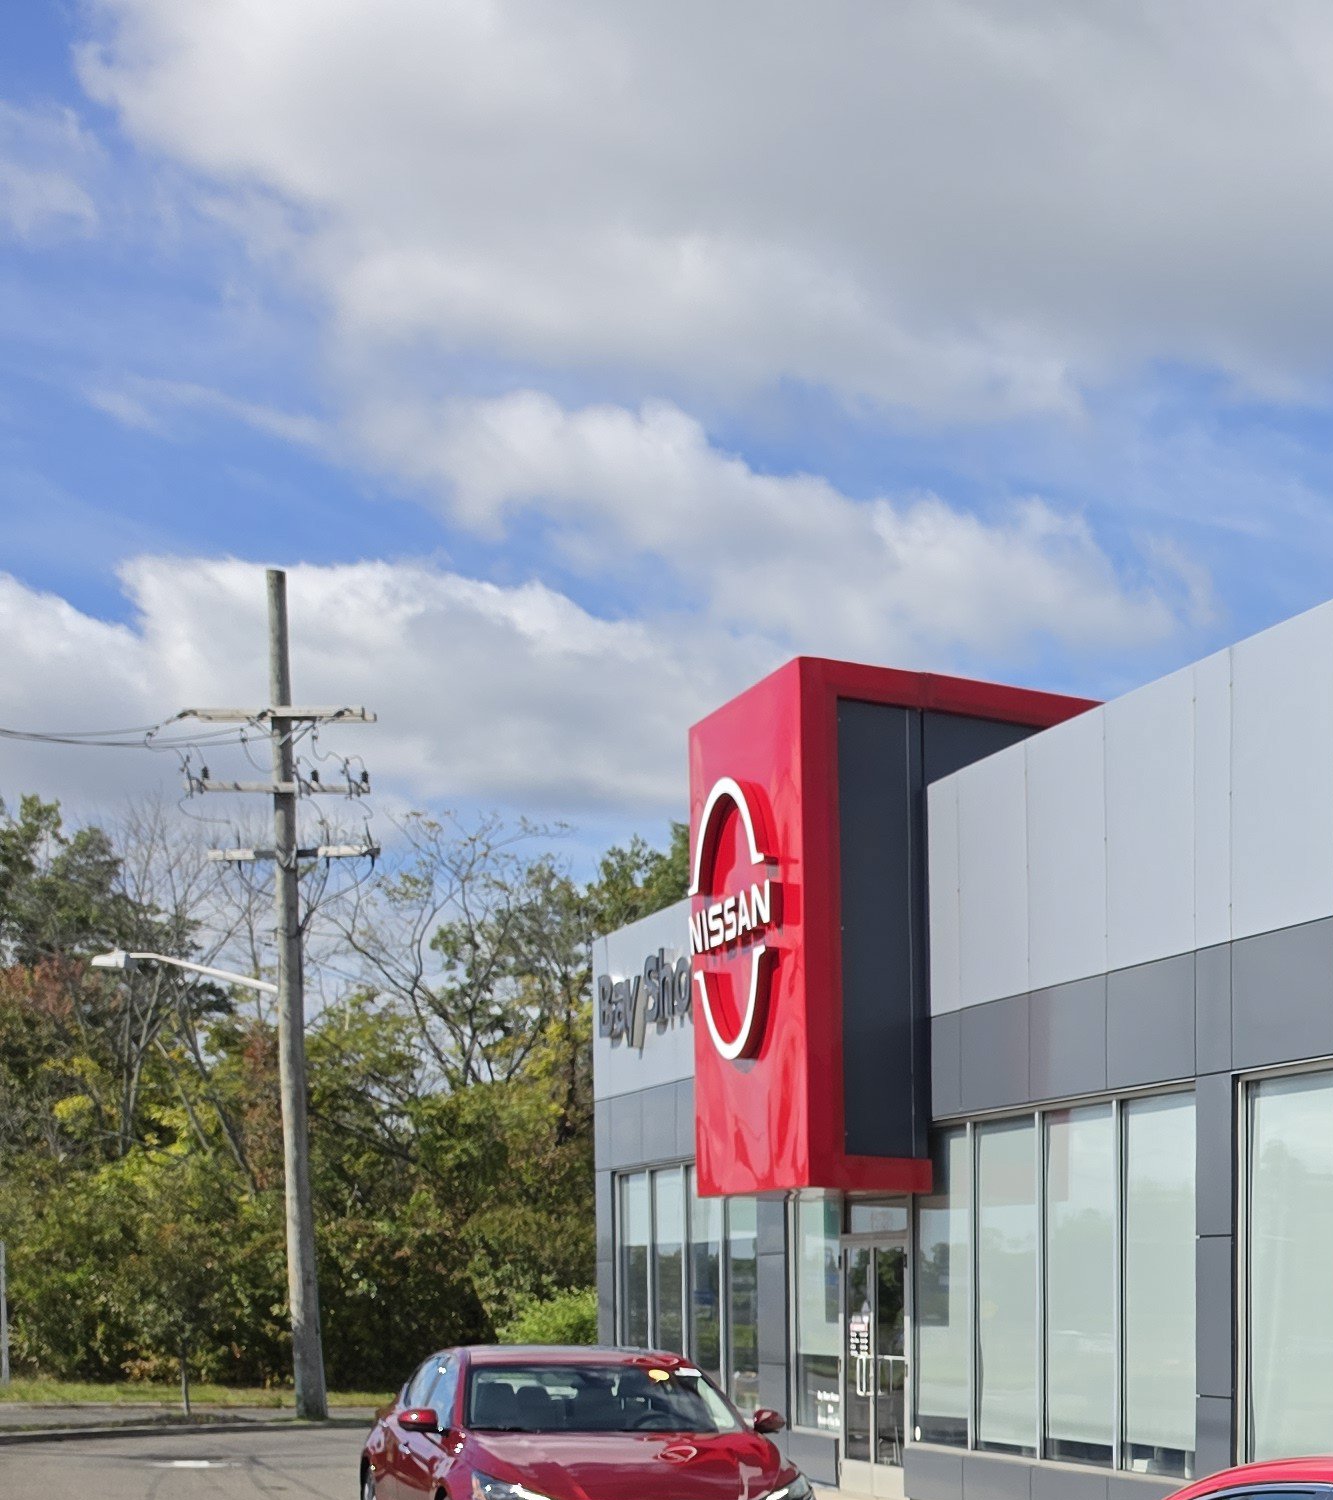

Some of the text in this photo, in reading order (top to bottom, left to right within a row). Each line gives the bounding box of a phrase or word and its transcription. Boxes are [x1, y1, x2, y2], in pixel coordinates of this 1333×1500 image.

[688, 878, 770, 955] NISSAN
[598, 948, 693, 1049] Bay Sho
